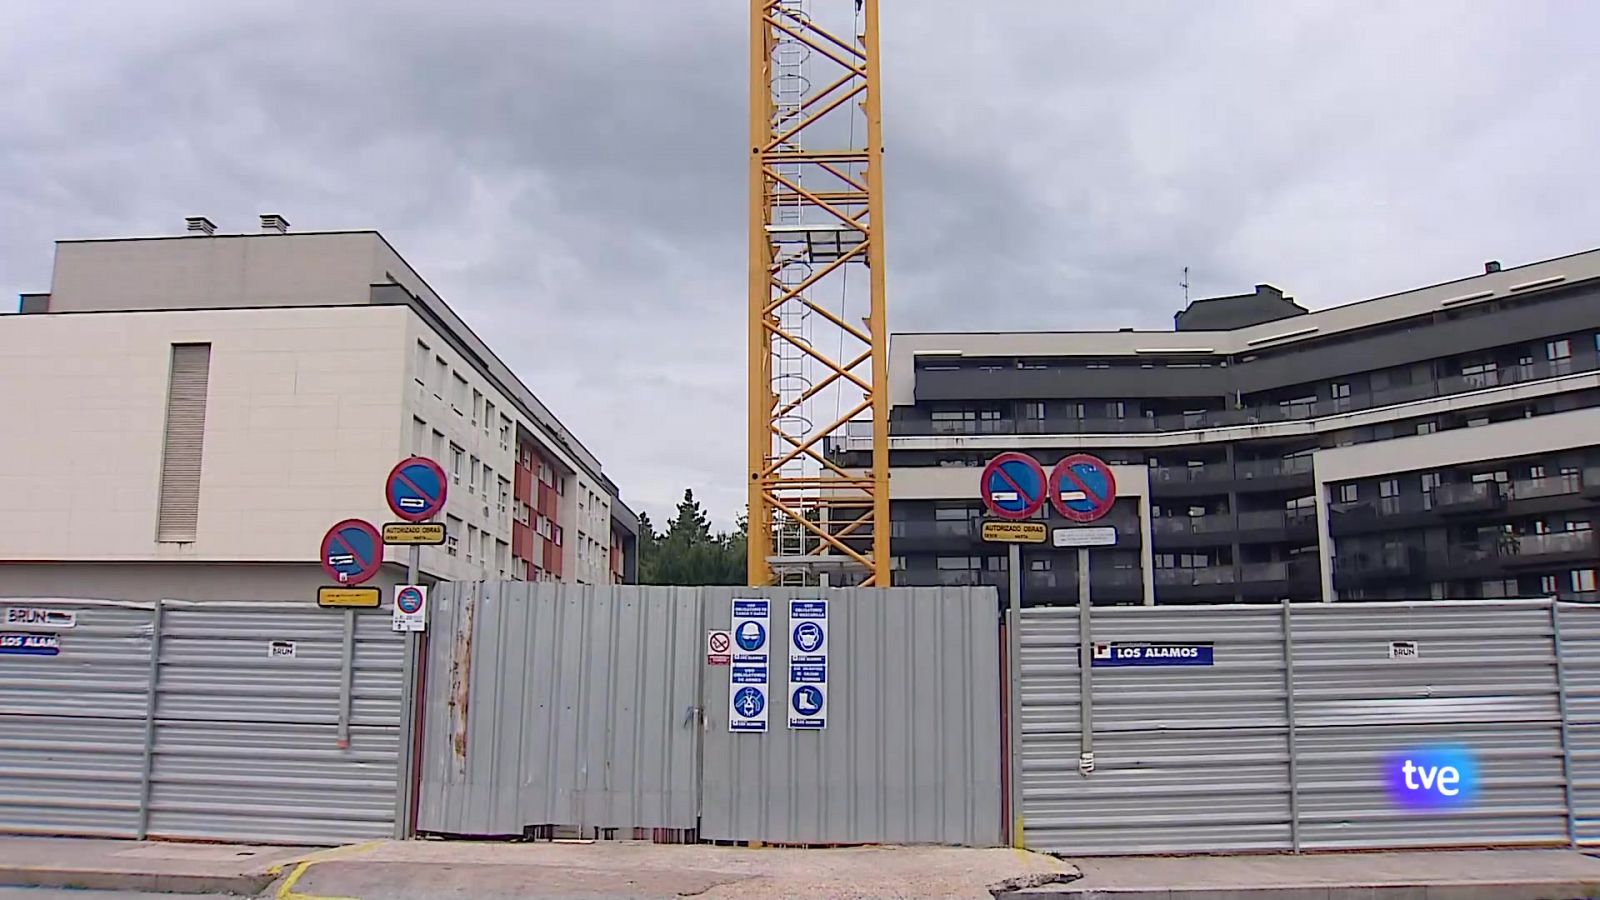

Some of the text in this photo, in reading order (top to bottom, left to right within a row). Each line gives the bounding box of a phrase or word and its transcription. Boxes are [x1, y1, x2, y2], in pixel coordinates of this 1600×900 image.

[422, 526, 441, 534] OBRAS
[985, 524, 1021, 532] AUTORIZADO
[8, 609, 46, 623] BRUN
[0, 636, 23, 647] LOS
[272, 647, 293, 656] BRUN
[1117, 648, 1198, 658] LOS ALAMOS
[1393, 648, 1415, 656] BRUN
